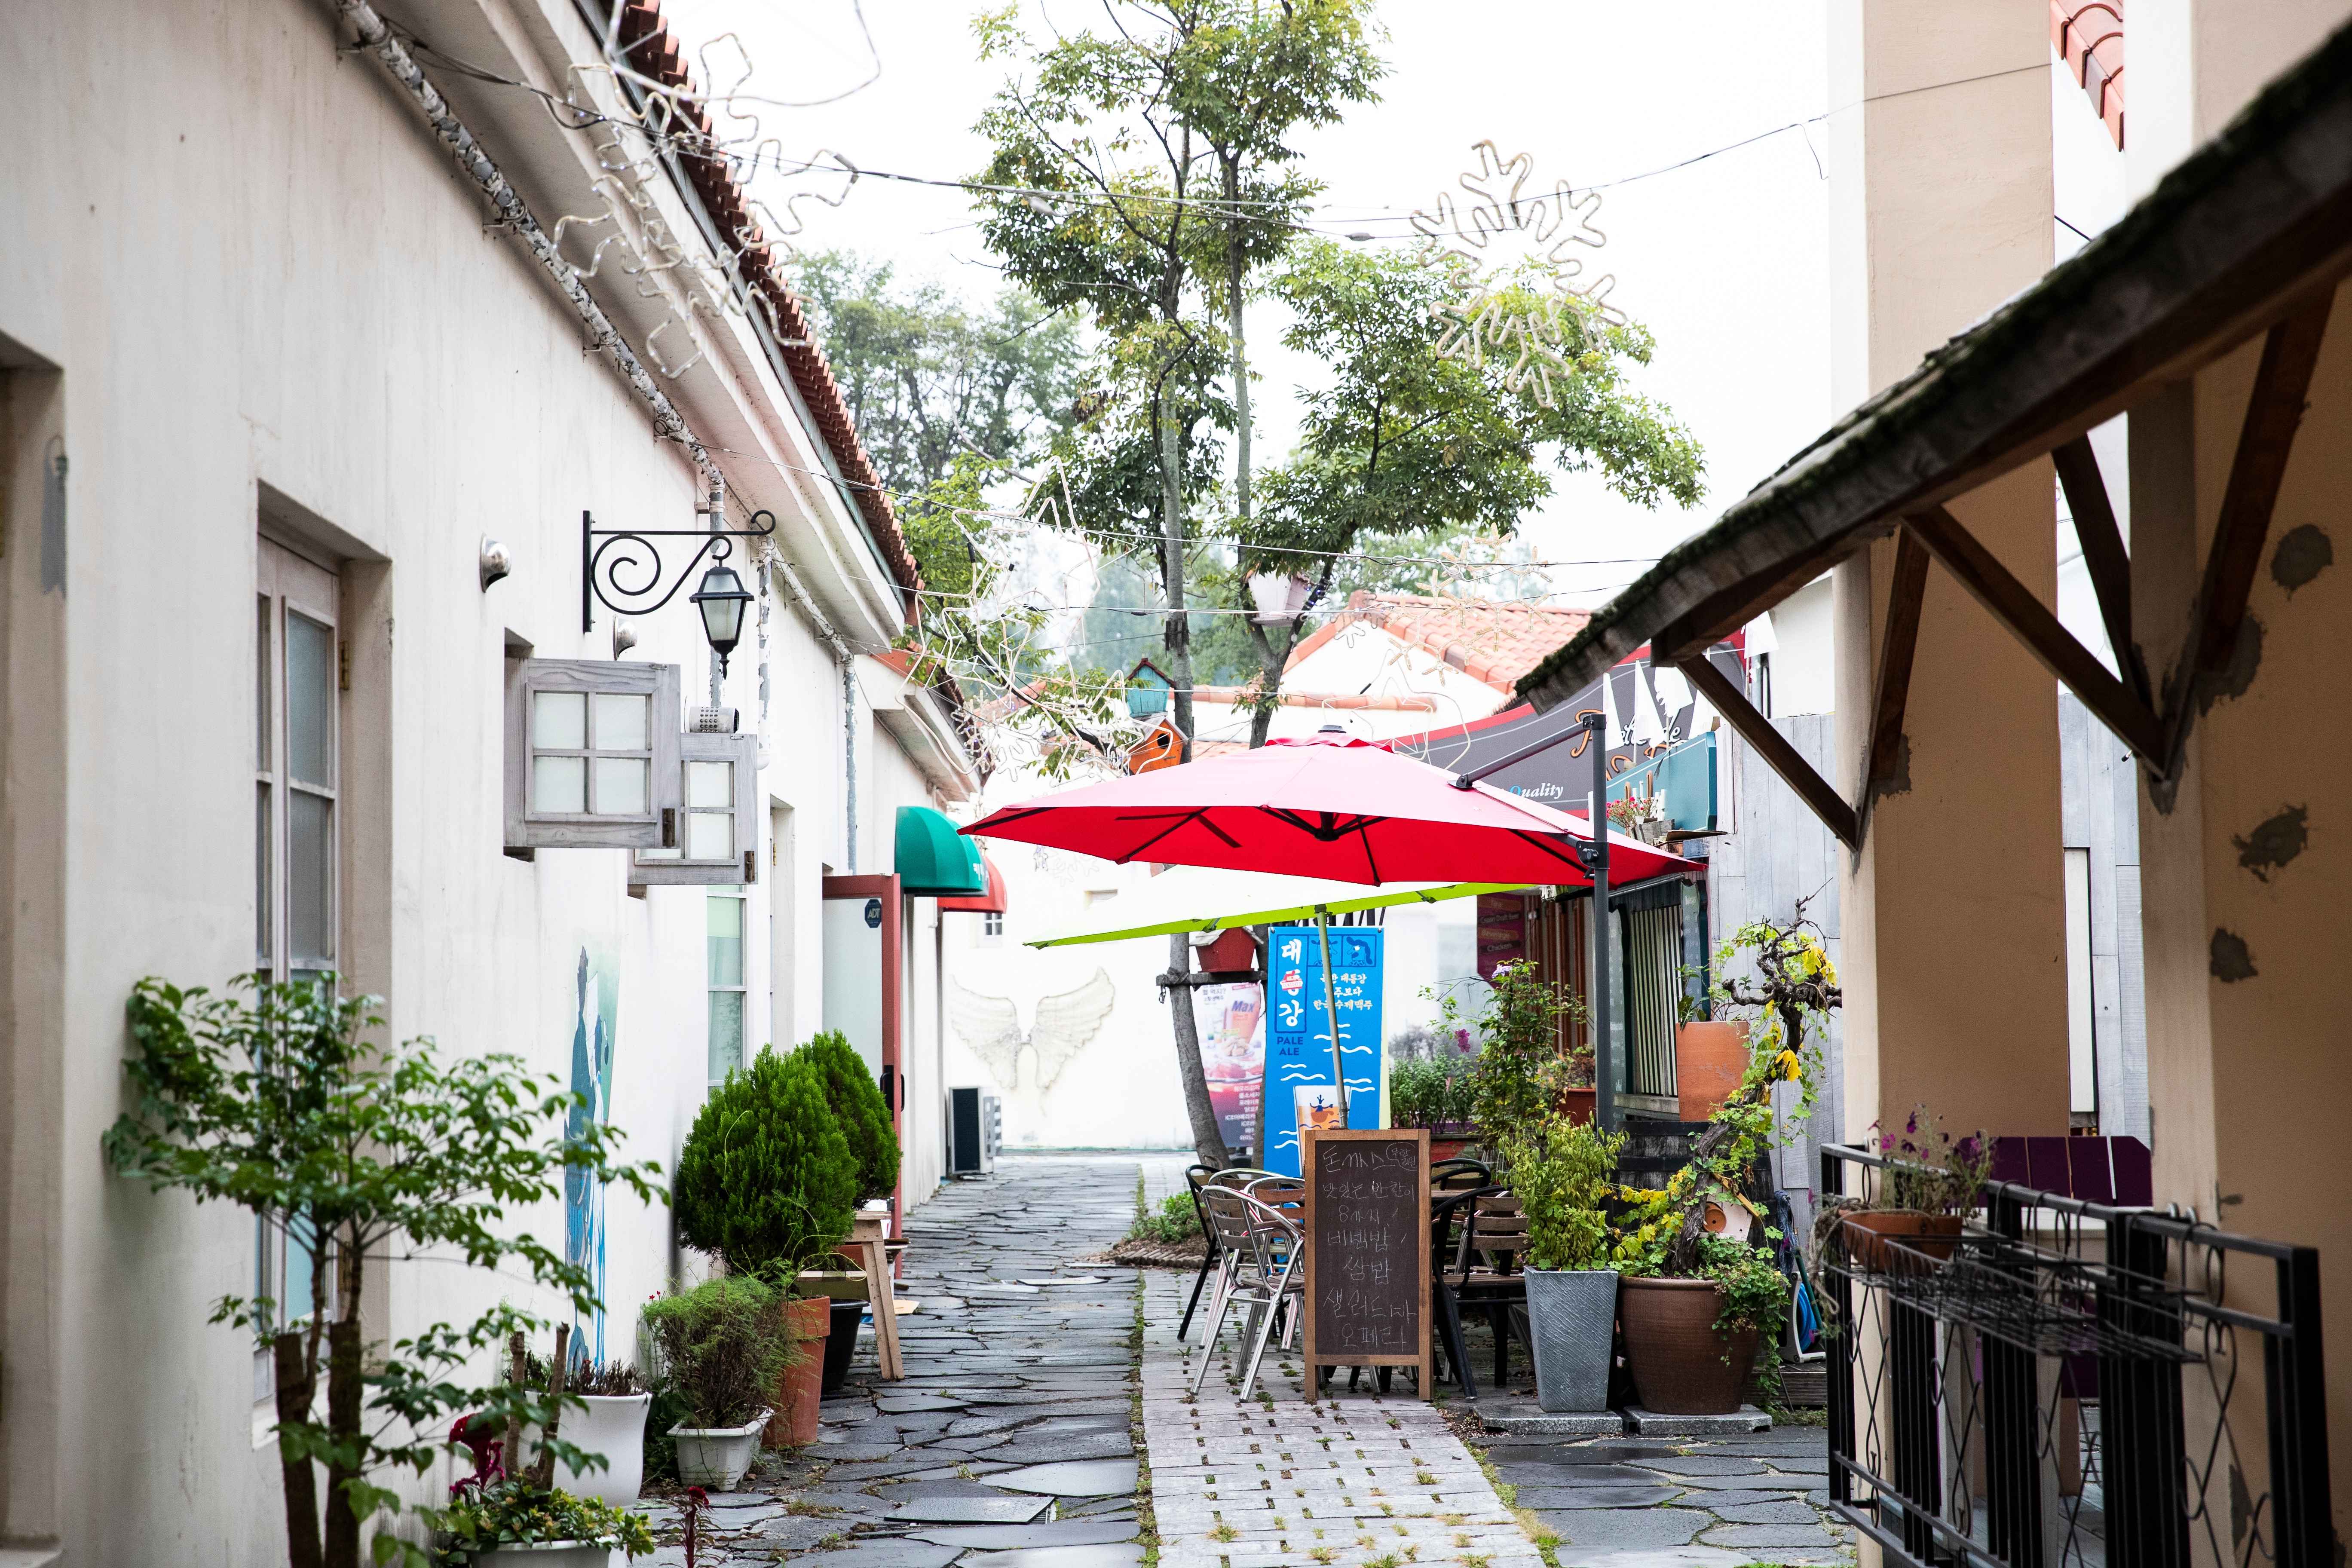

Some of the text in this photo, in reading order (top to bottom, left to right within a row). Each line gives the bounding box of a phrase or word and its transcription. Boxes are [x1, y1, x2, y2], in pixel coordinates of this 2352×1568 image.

[1509, 782, 1564, 799] Quality
[867, 908, 880, 919] ADT
[1340, 973, 1367, 984] 대동강
[1231, 1000, 1255, 1012] Max
[1277, 1036, 1304, 1045] PALE
[1279, 1047, 1299, 1056] ALE
[1323, 1181, 1415, 1202] 맛있는 반찬이
[1343, 1256, 1393, 1285] 쌈밥
[1323, 1287, 1417, 1324] 샐러드바
[1341, 1323, 1407, 1352] 오페라
